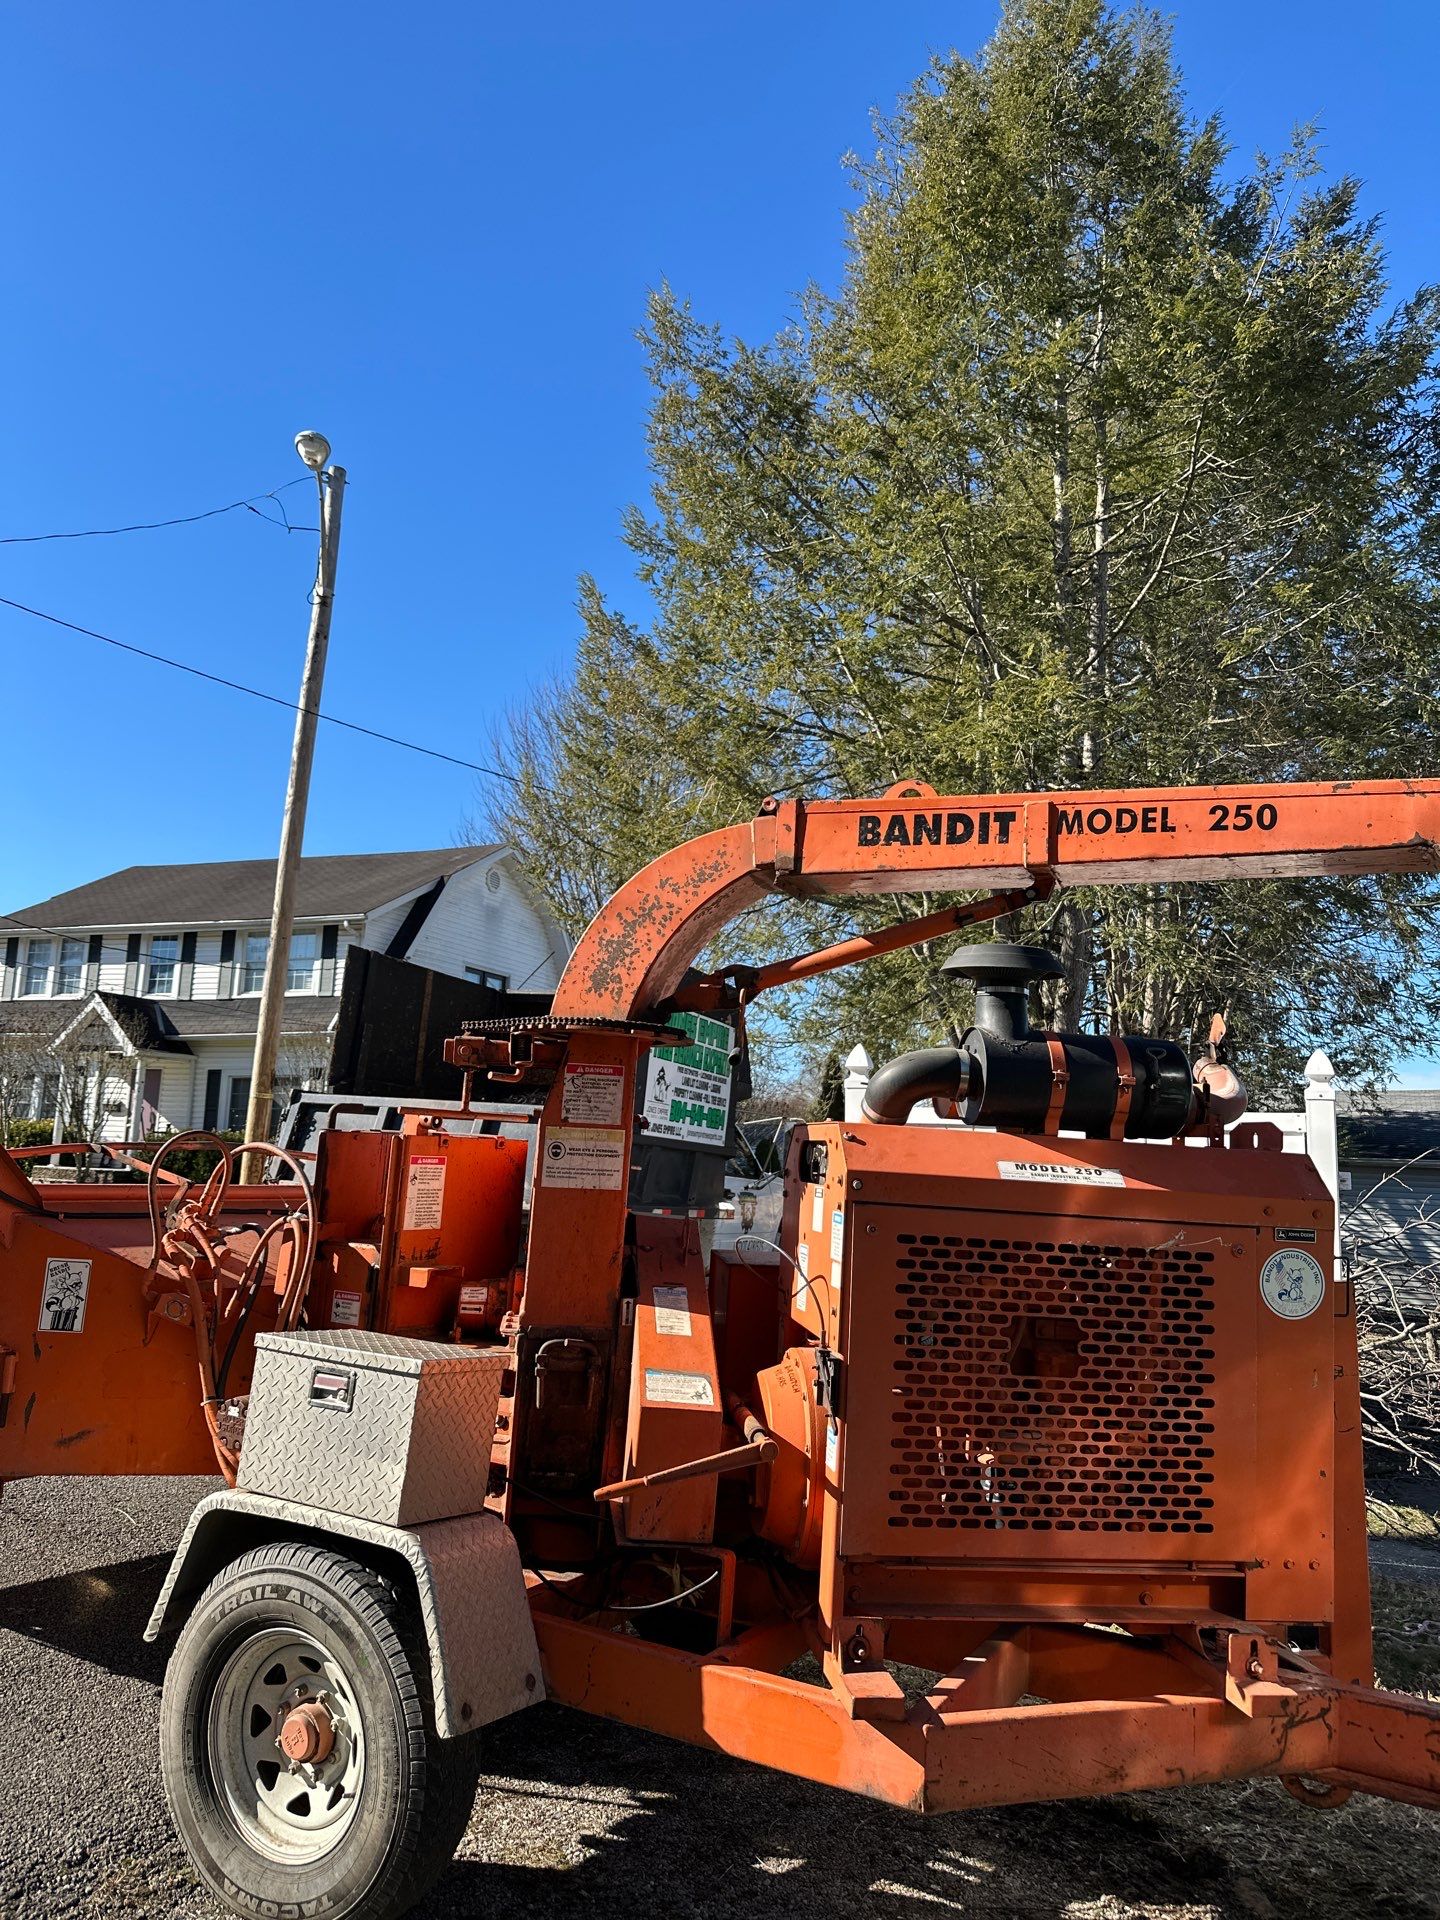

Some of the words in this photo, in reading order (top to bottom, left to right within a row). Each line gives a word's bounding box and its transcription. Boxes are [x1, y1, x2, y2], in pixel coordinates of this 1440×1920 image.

[858, 810, 1017, 847] BANDIT
[1057, 806, 1176, 836] MODEL
[1208, 803, 1278, 832] 250
[584, 1066, 614, 1074] DANGER
[1014, 1163, 1068, 1174] MODEL
[1075, 1167, 1103, 1176] 250
[49, 1262, 69, 1273] BRUSH
[50, 1266, 71, 1278] BANDIT
[1265, 1259, 1279, 1283] BANDIT
[1279, 1253, 1316, 1271] INDUSTRIES
[211, 1585, 278, 1623] TRAIL
[285, 1588, 340, 1624] AWT
[223, 1877, 334, 1919] TACOMA
